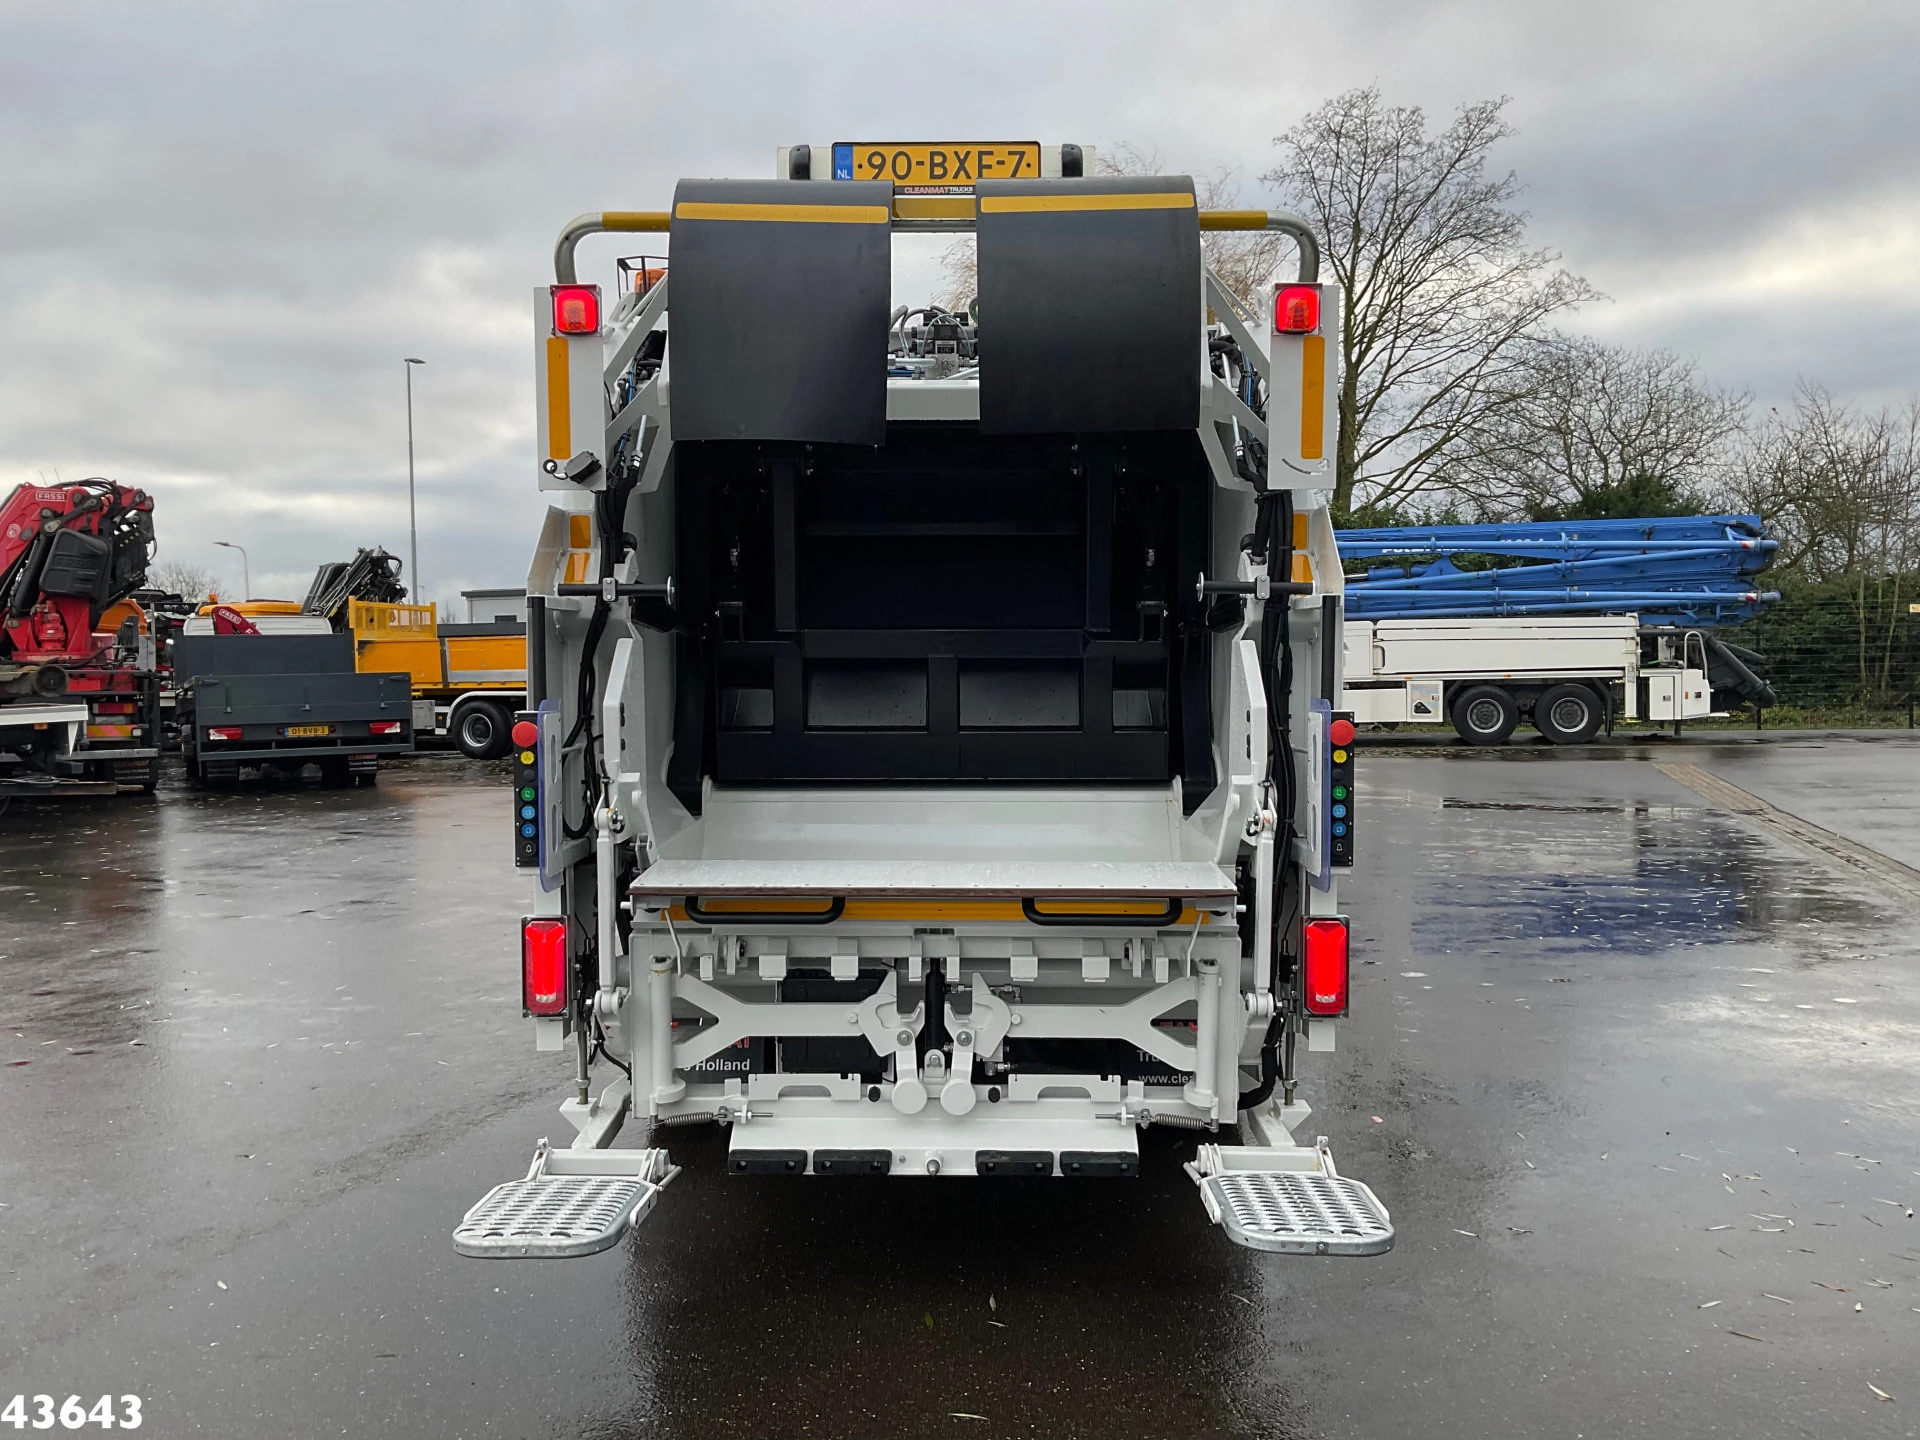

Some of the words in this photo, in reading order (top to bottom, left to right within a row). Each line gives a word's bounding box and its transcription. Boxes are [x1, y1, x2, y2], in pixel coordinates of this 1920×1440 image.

[867, 150, 1026, 180] 90-BXF-7
[837, 169, 851, 179] NL
[38, 492, 65, 500] FASSI
[1136, 1049, 1160, 1062] Tru
[695, 1058, 751, 1071] Holland
